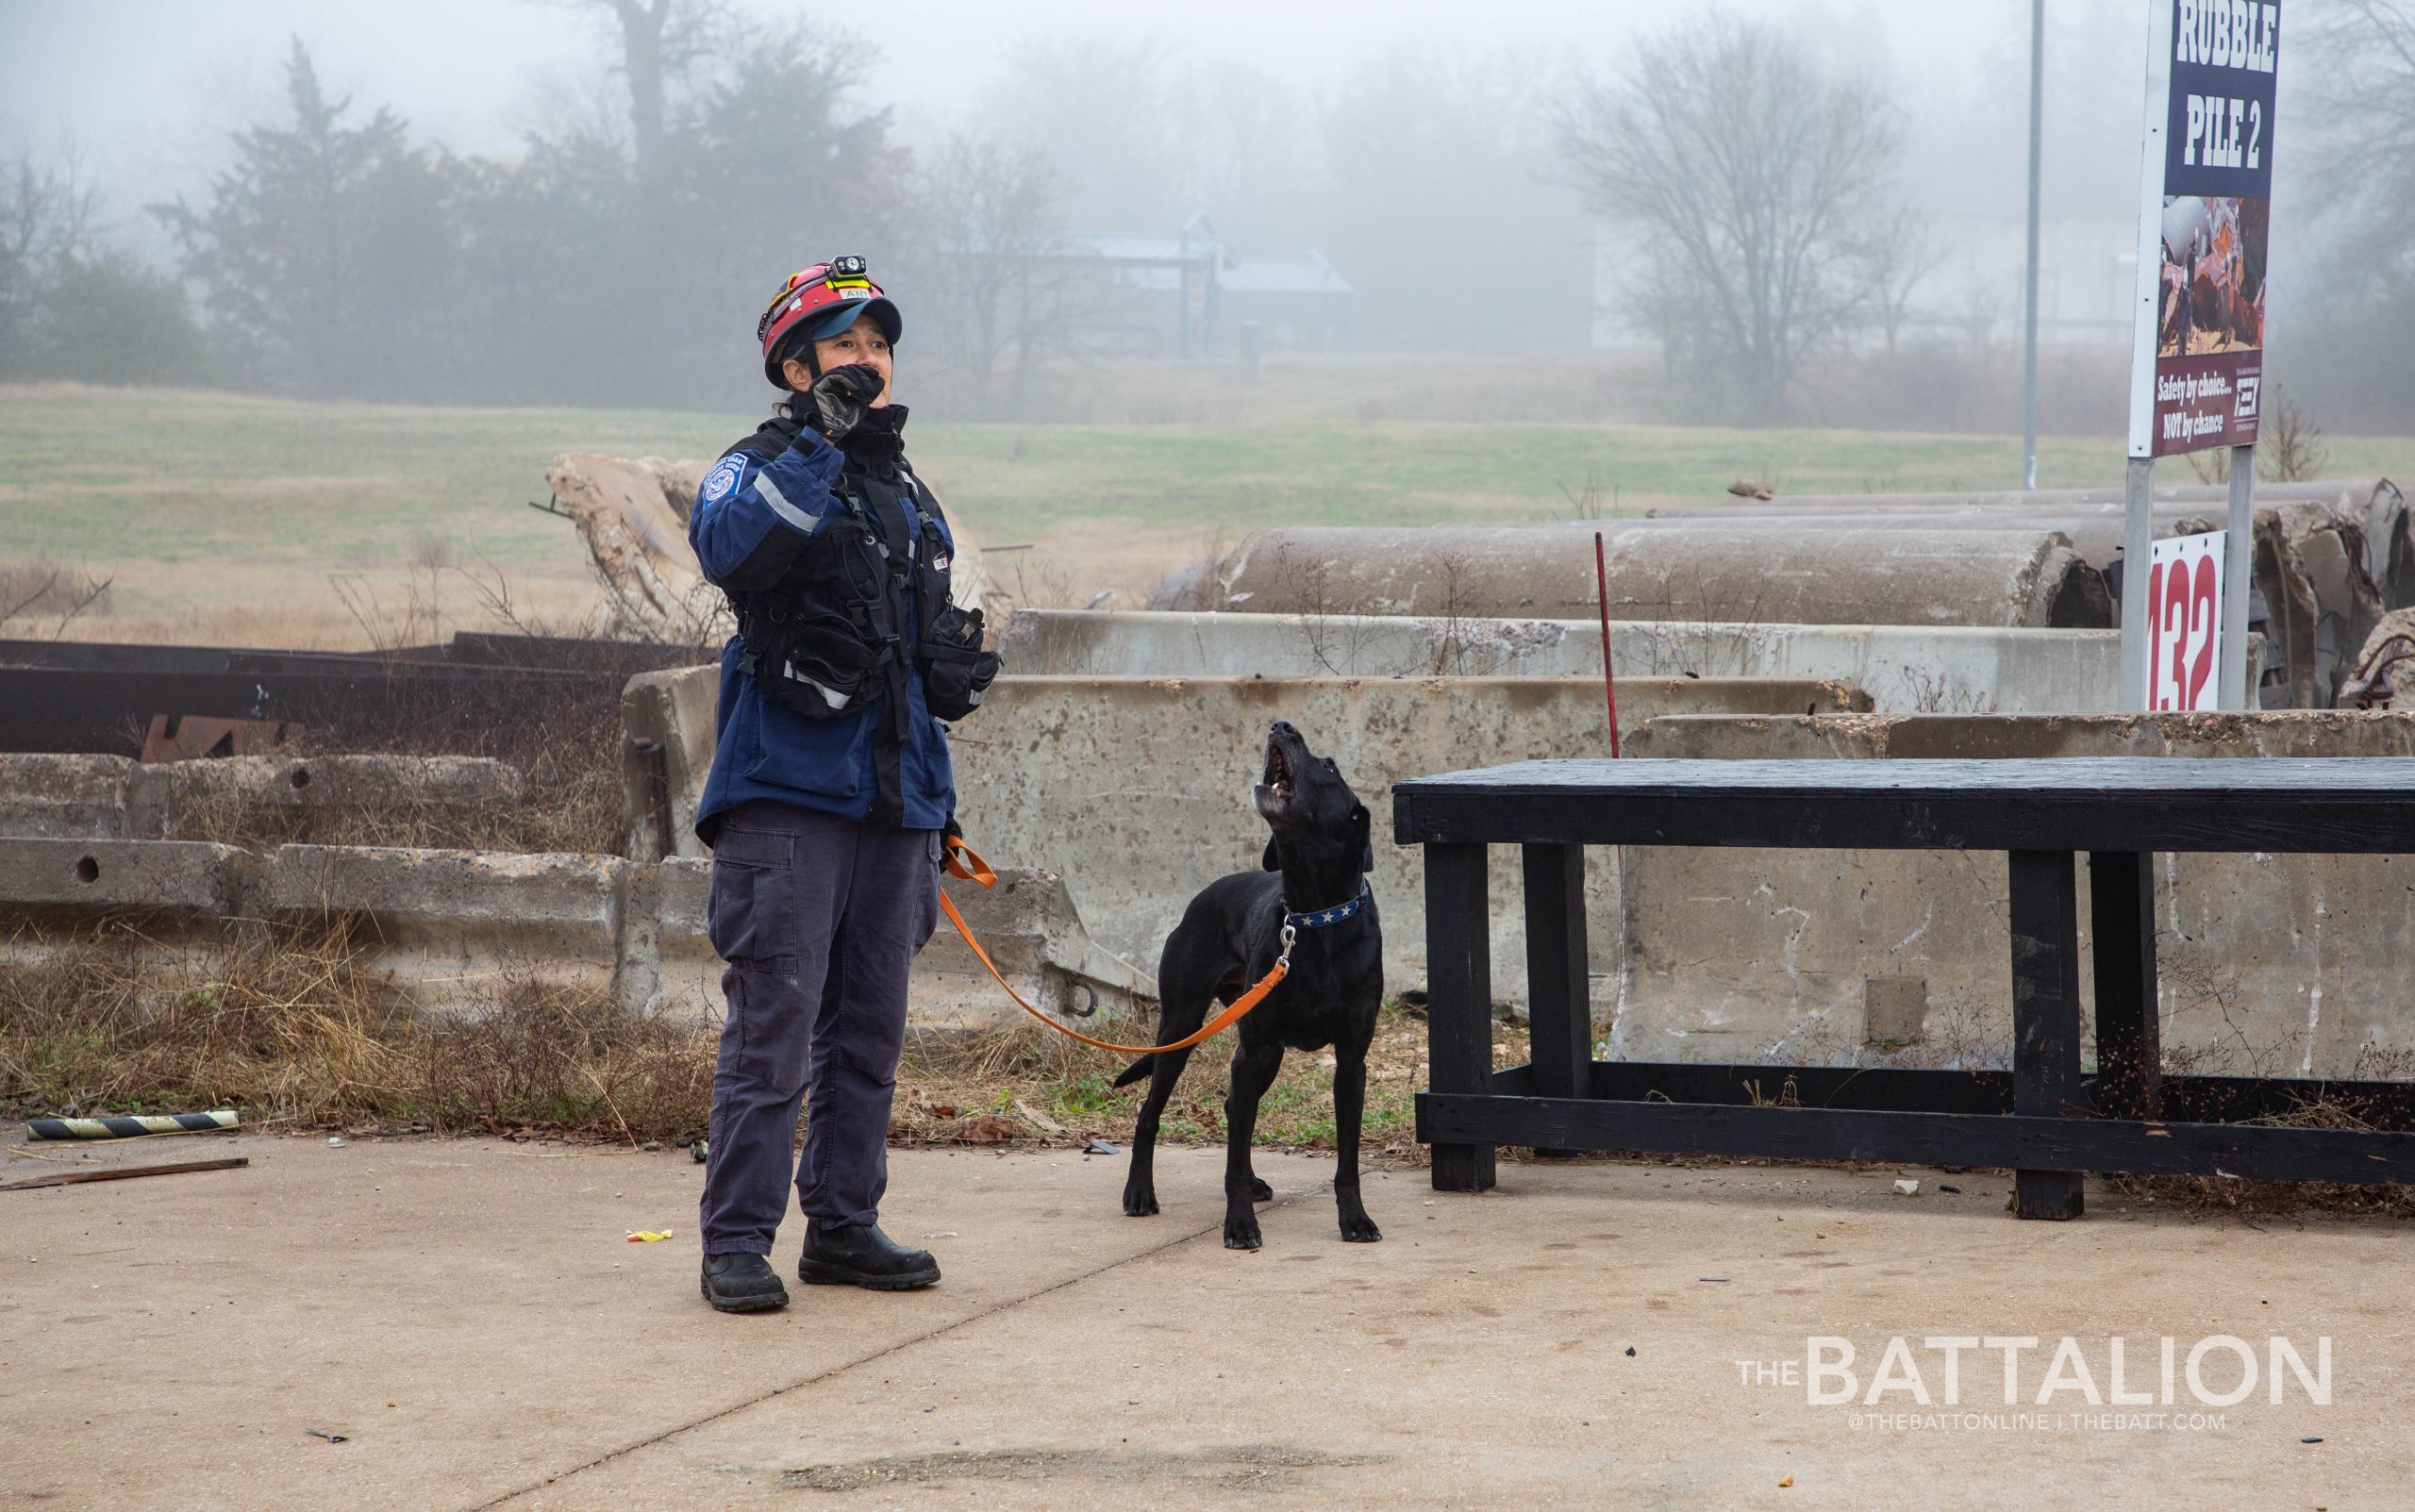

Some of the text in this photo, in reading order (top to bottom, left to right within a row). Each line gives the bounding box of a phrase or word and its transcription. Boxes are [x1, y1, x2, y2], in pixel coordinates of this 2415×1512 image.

[2177, 0, 2276, 74] RUBBLE
[2184, 94, 2261, 169] PILE 2
[2157, 374, 2186, 407] Safety
[2186, 373, 2198, 406] by
[2163, 409, 2223, 443] NOT by chance
[2148, 555, 2216, 711] 132
